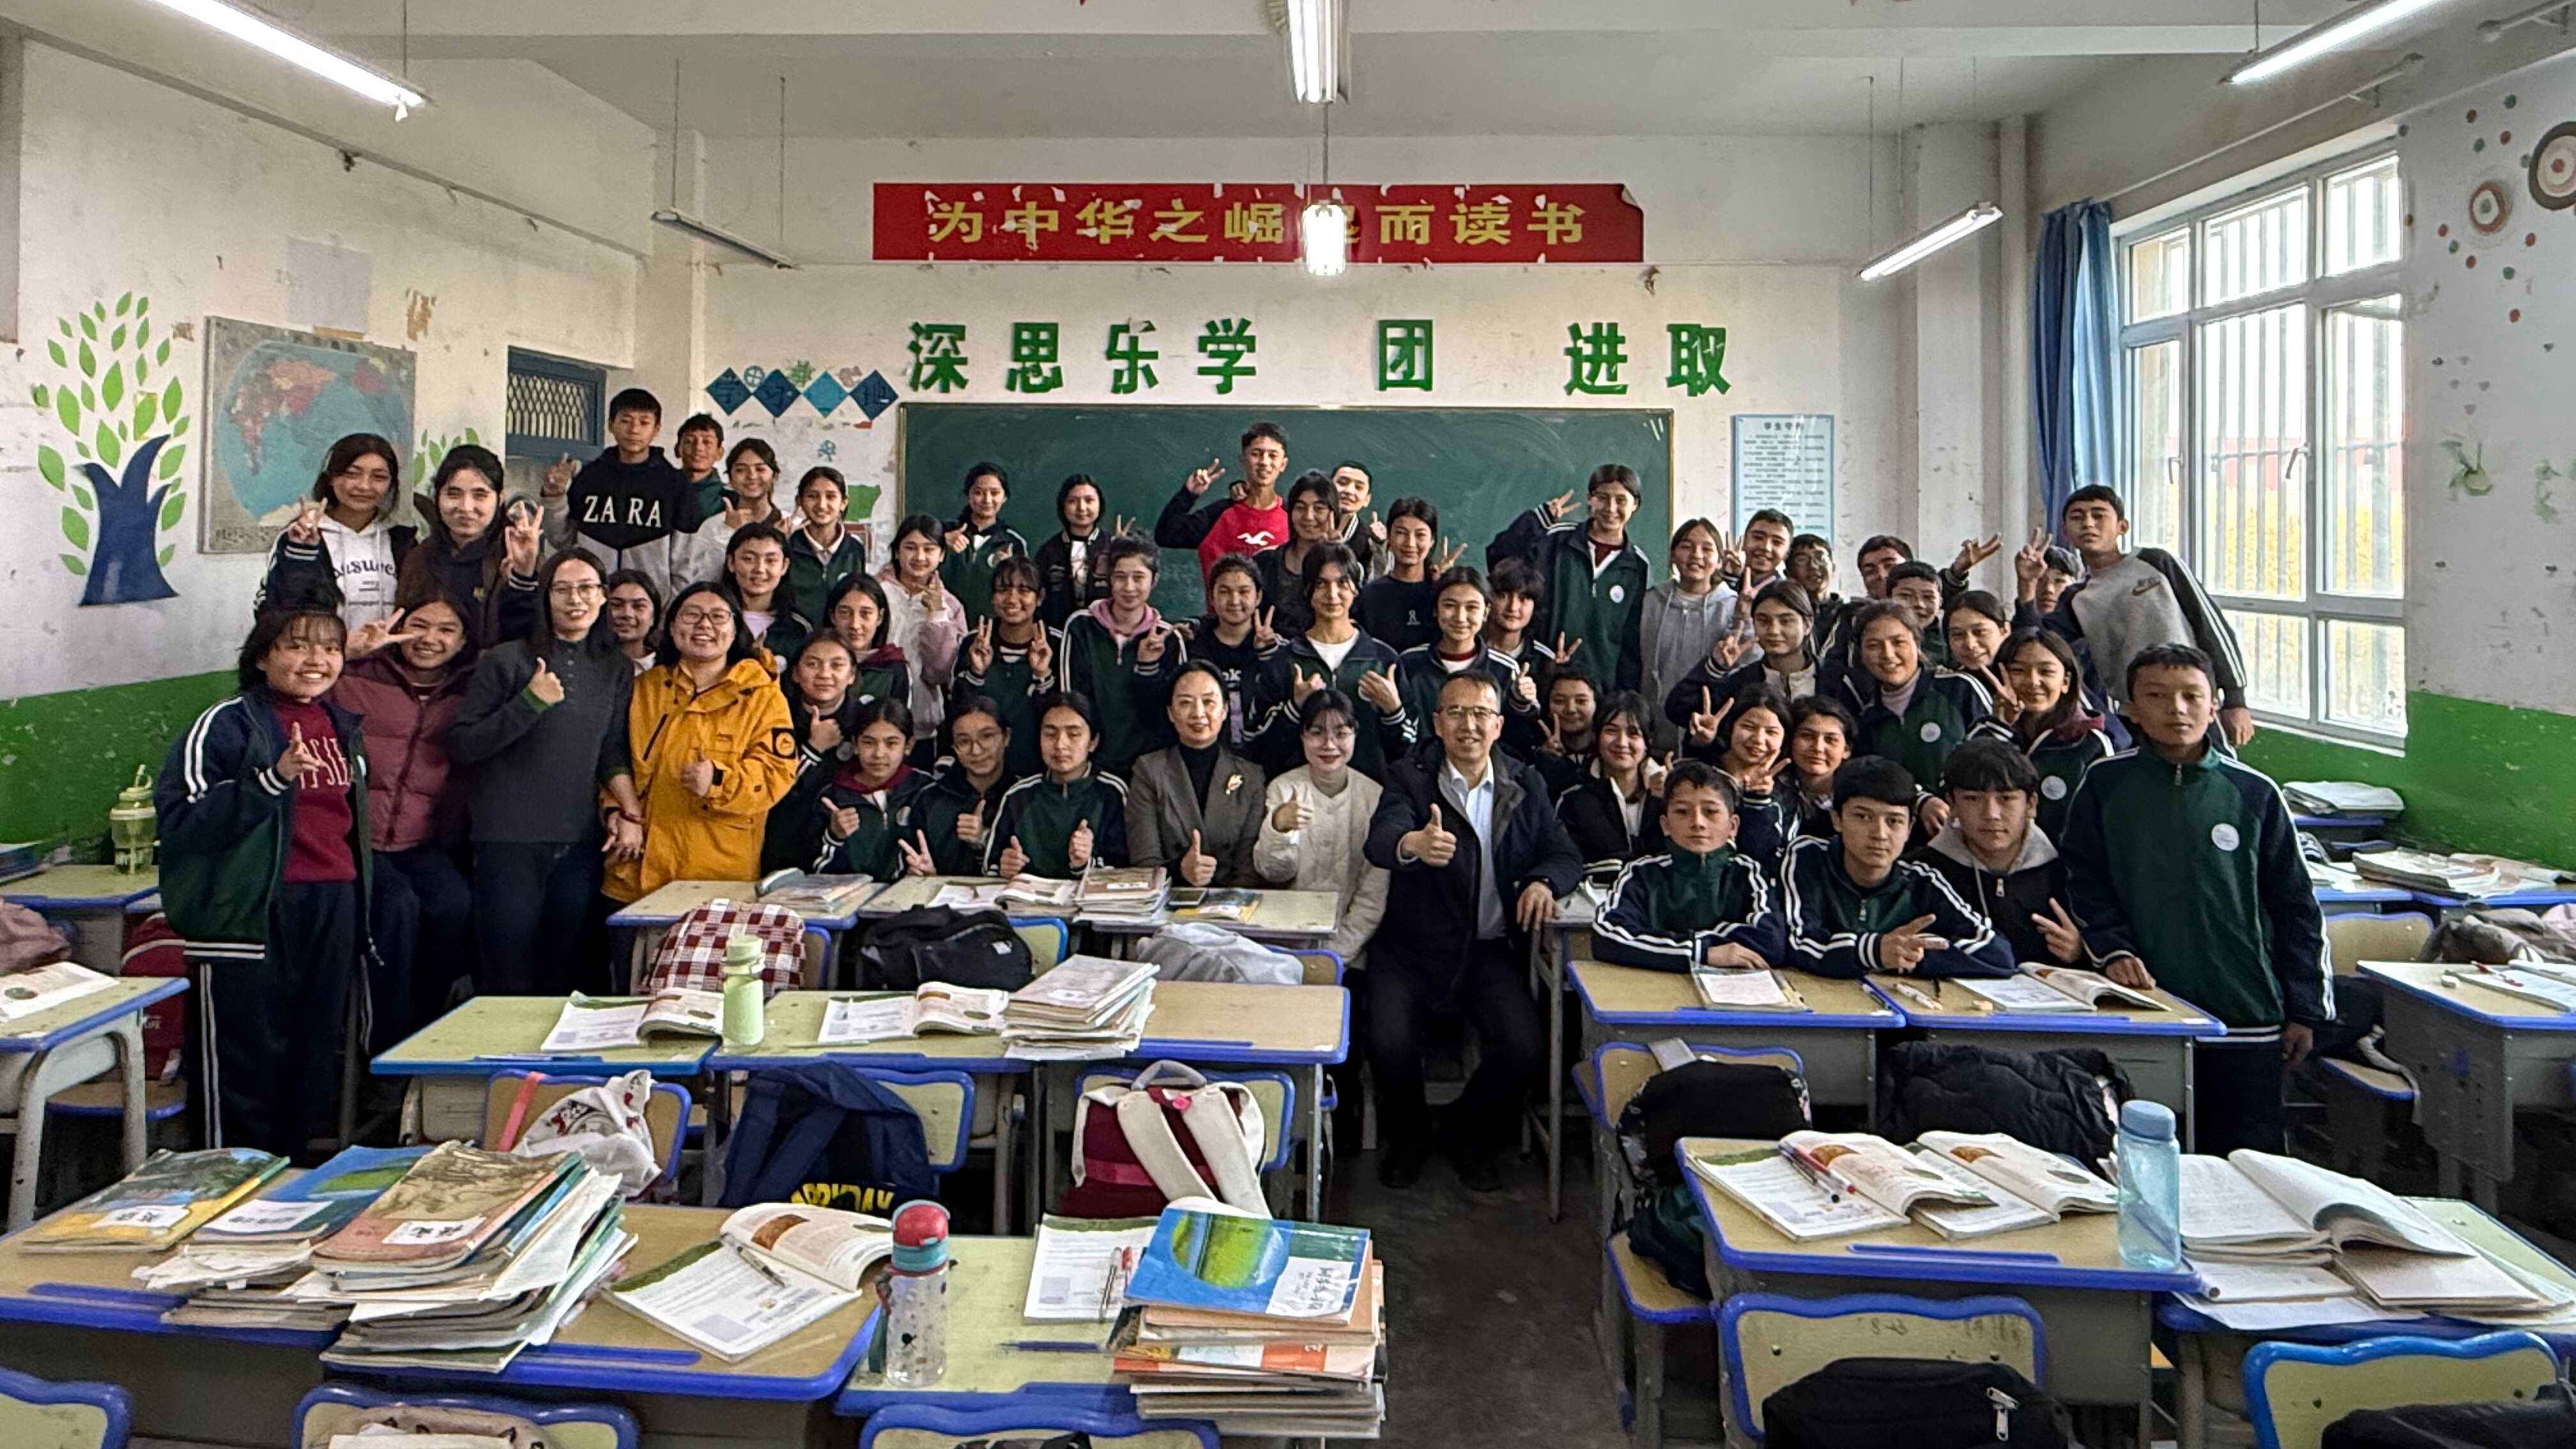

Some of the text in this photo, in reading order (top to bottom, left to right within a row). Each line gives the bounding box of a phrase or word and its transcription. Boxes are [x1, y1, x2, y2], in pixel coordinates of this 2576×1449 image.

[928, 201, 1586, 247] 为中华之崛而读书
